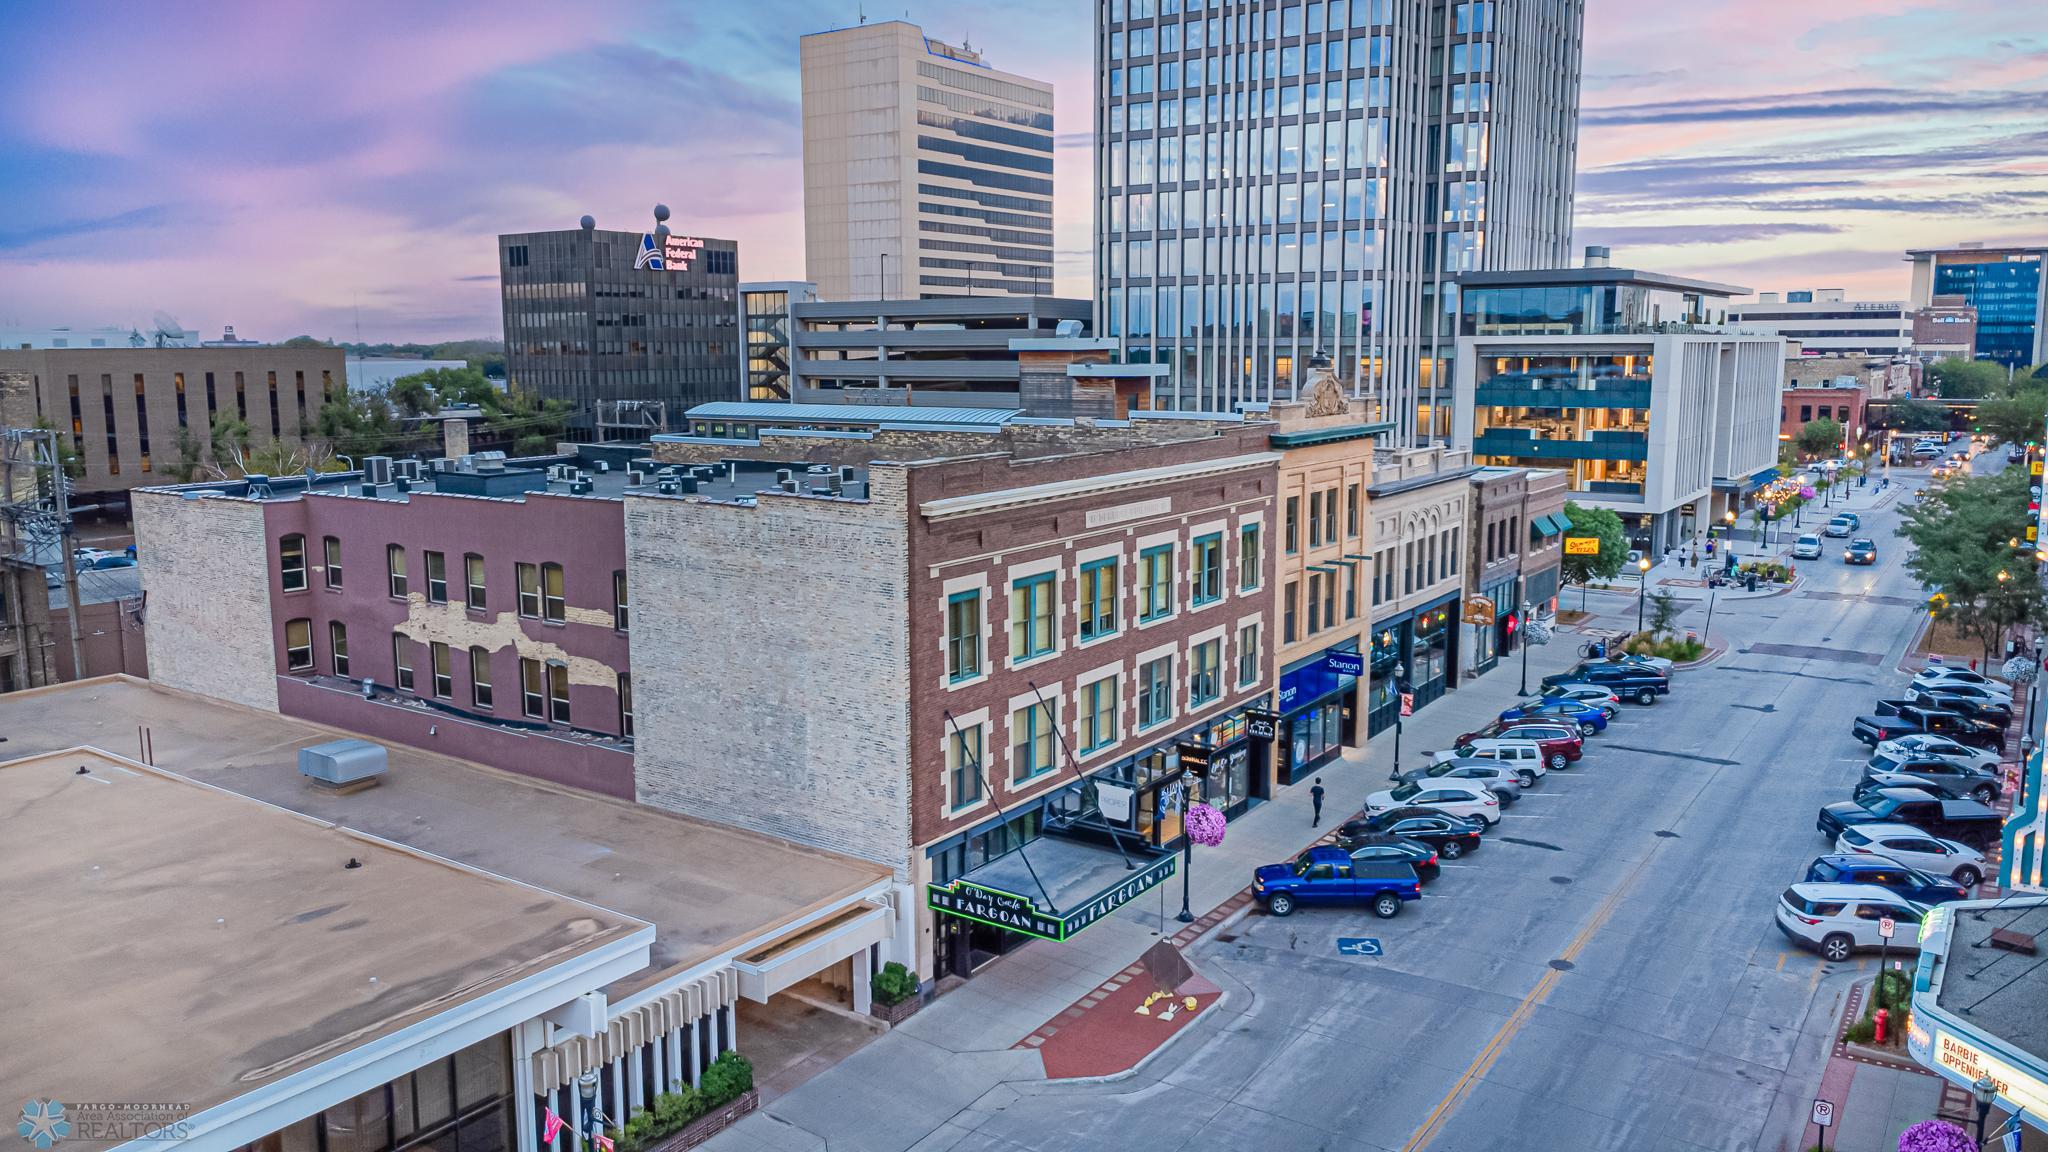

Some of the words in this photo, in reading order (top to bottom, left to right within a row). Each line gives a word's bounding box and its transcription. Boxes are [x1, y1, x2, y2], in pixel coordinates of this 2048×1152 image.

[666, 235, 704, 248] American
[666, 247, 696, 260] Federal
[666, 260, 688, 271] Bank
[1089, 874, 1153, 921] FARGOAN
[956, 899, 1032, 929] FARGOAN
[1943, 1038, 1979, 1065] BARBIE
[1942, 1052, 2009, 1095] OPPENHEMER
